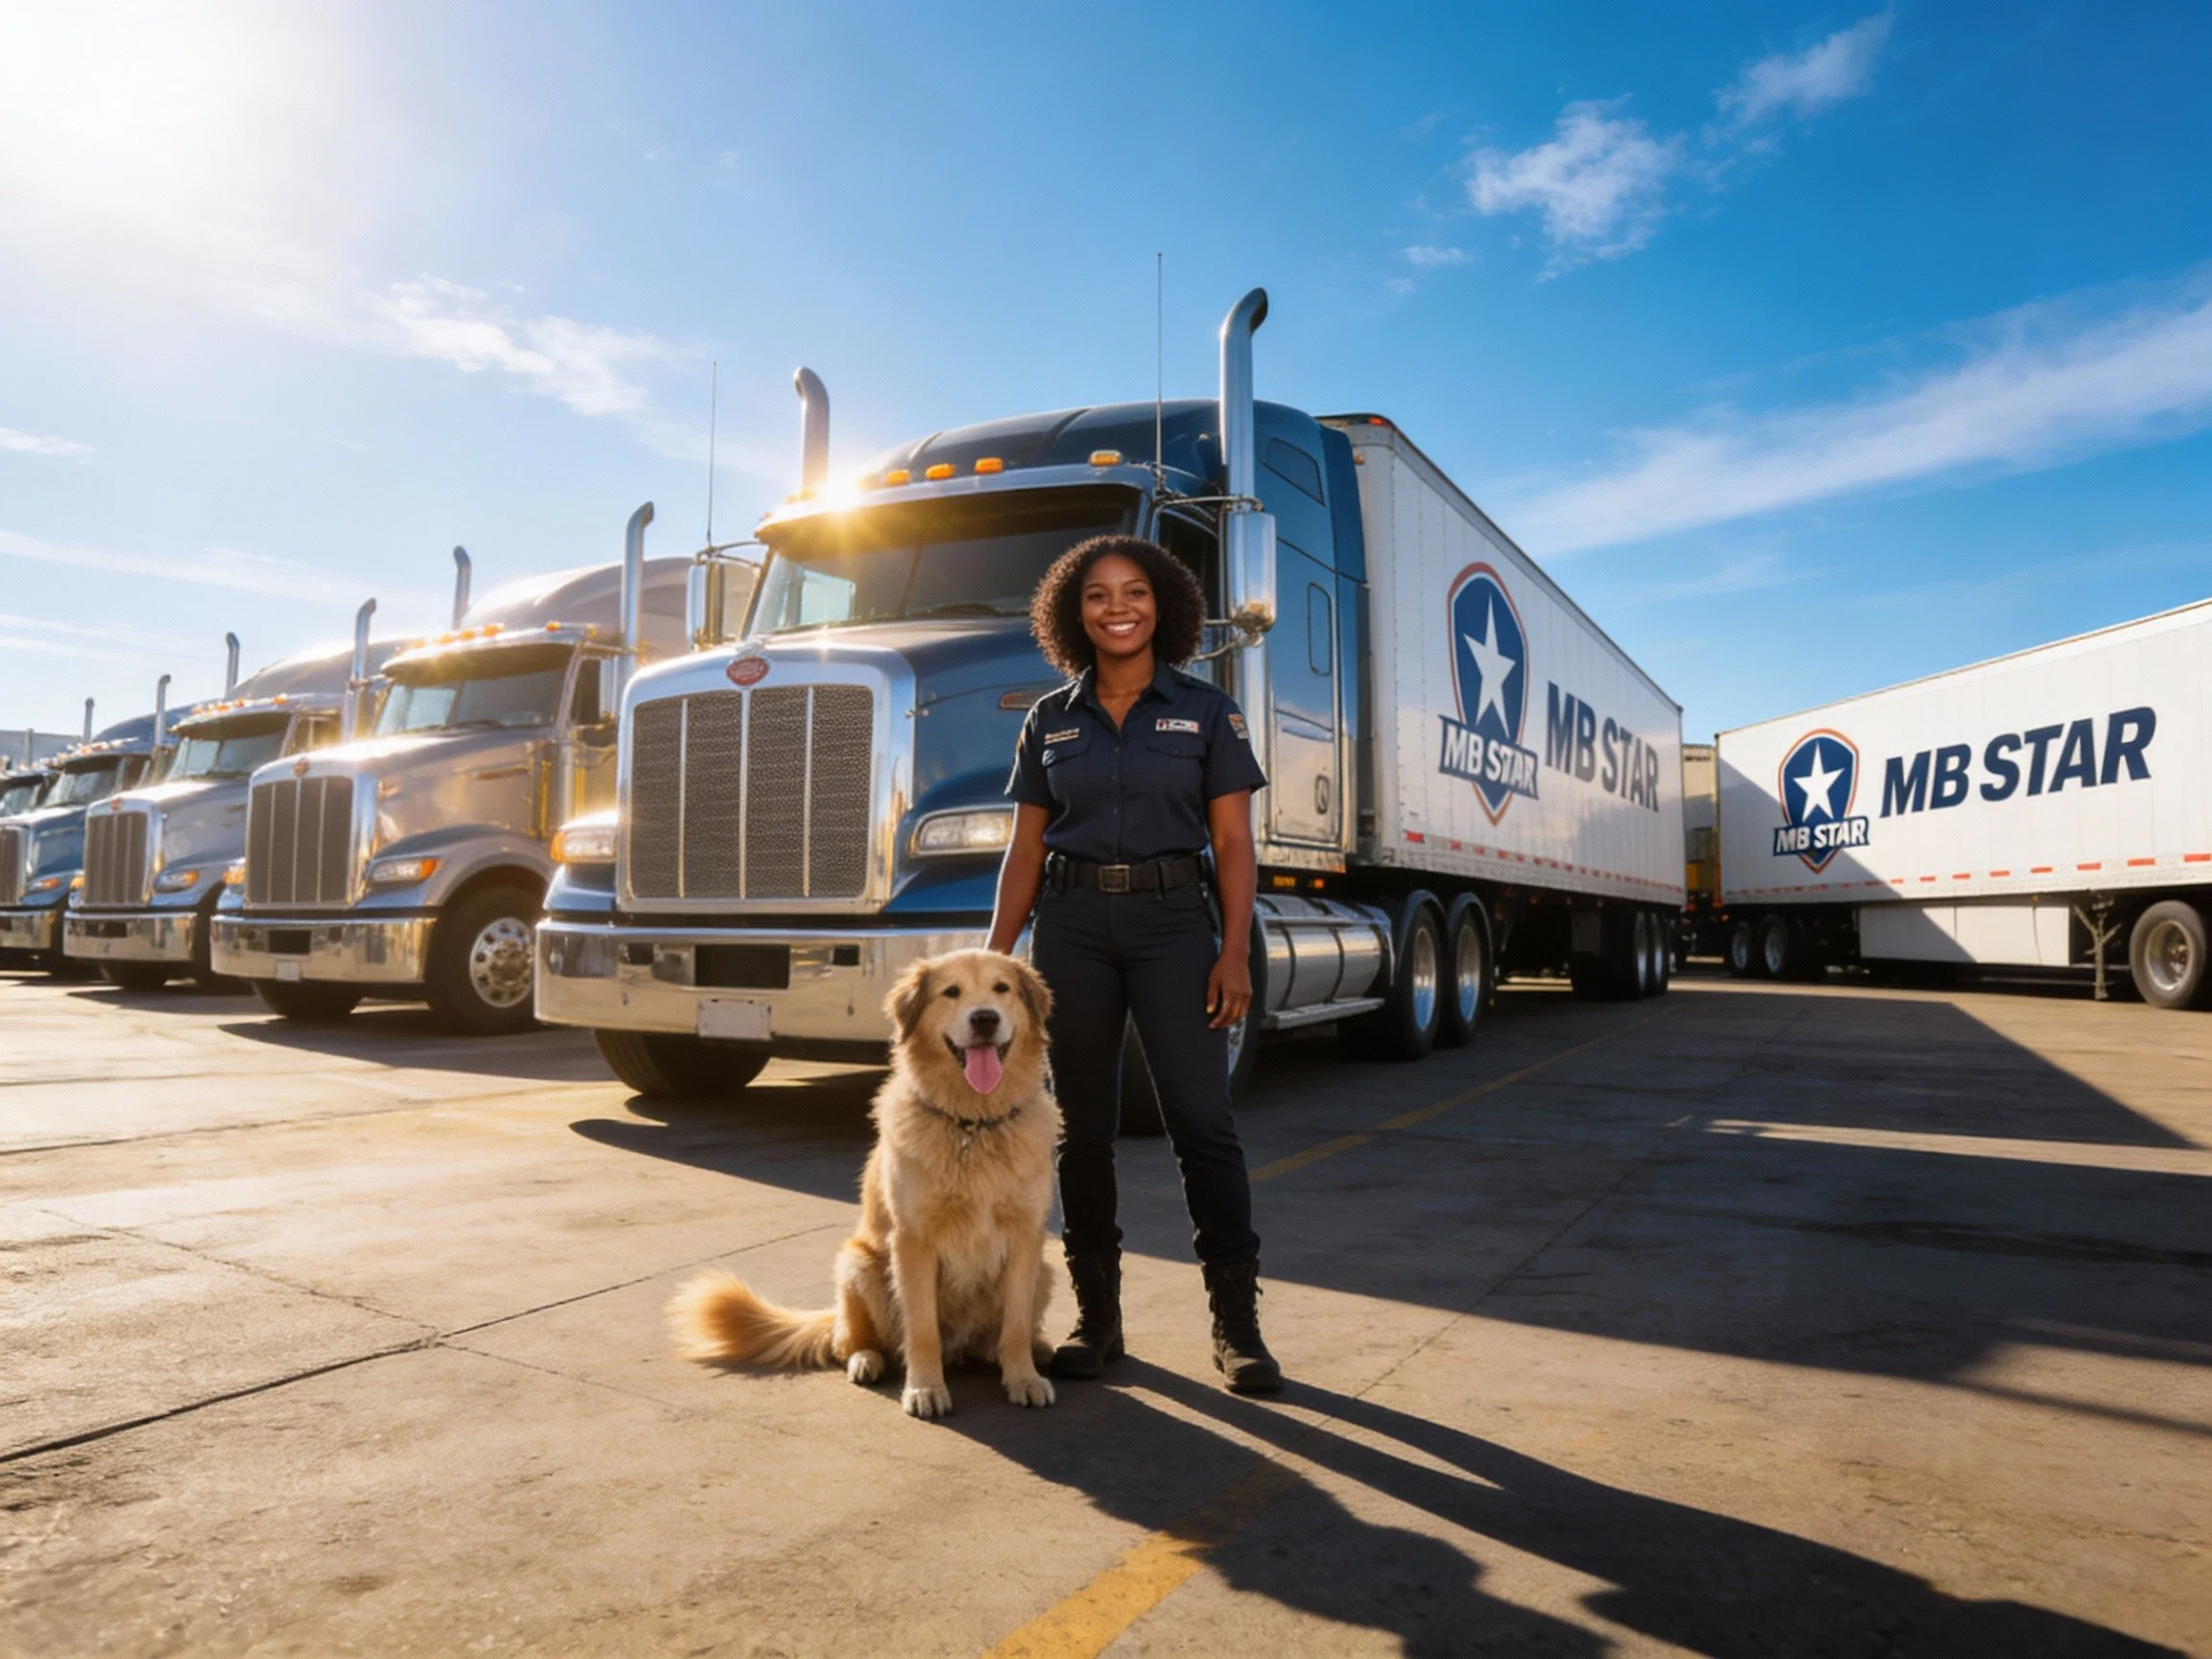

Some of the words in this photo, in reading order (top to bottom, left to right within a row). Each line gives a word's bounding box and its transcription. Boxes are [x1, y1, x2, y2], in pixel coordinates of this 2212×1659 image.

[1444, 725, 1484, 776] MB
[1486, 739, 1536, 794] STAR
[1546, 681, 1595, 782] MB
[1601, 717, 1659, 812] STAR
[1880, 743, 1972, 818] MB
[1980, 707, 2156, 802] STAR
[1776, 826, 1810, 853] MB
[1814, 819, 1867, 849] STAR
